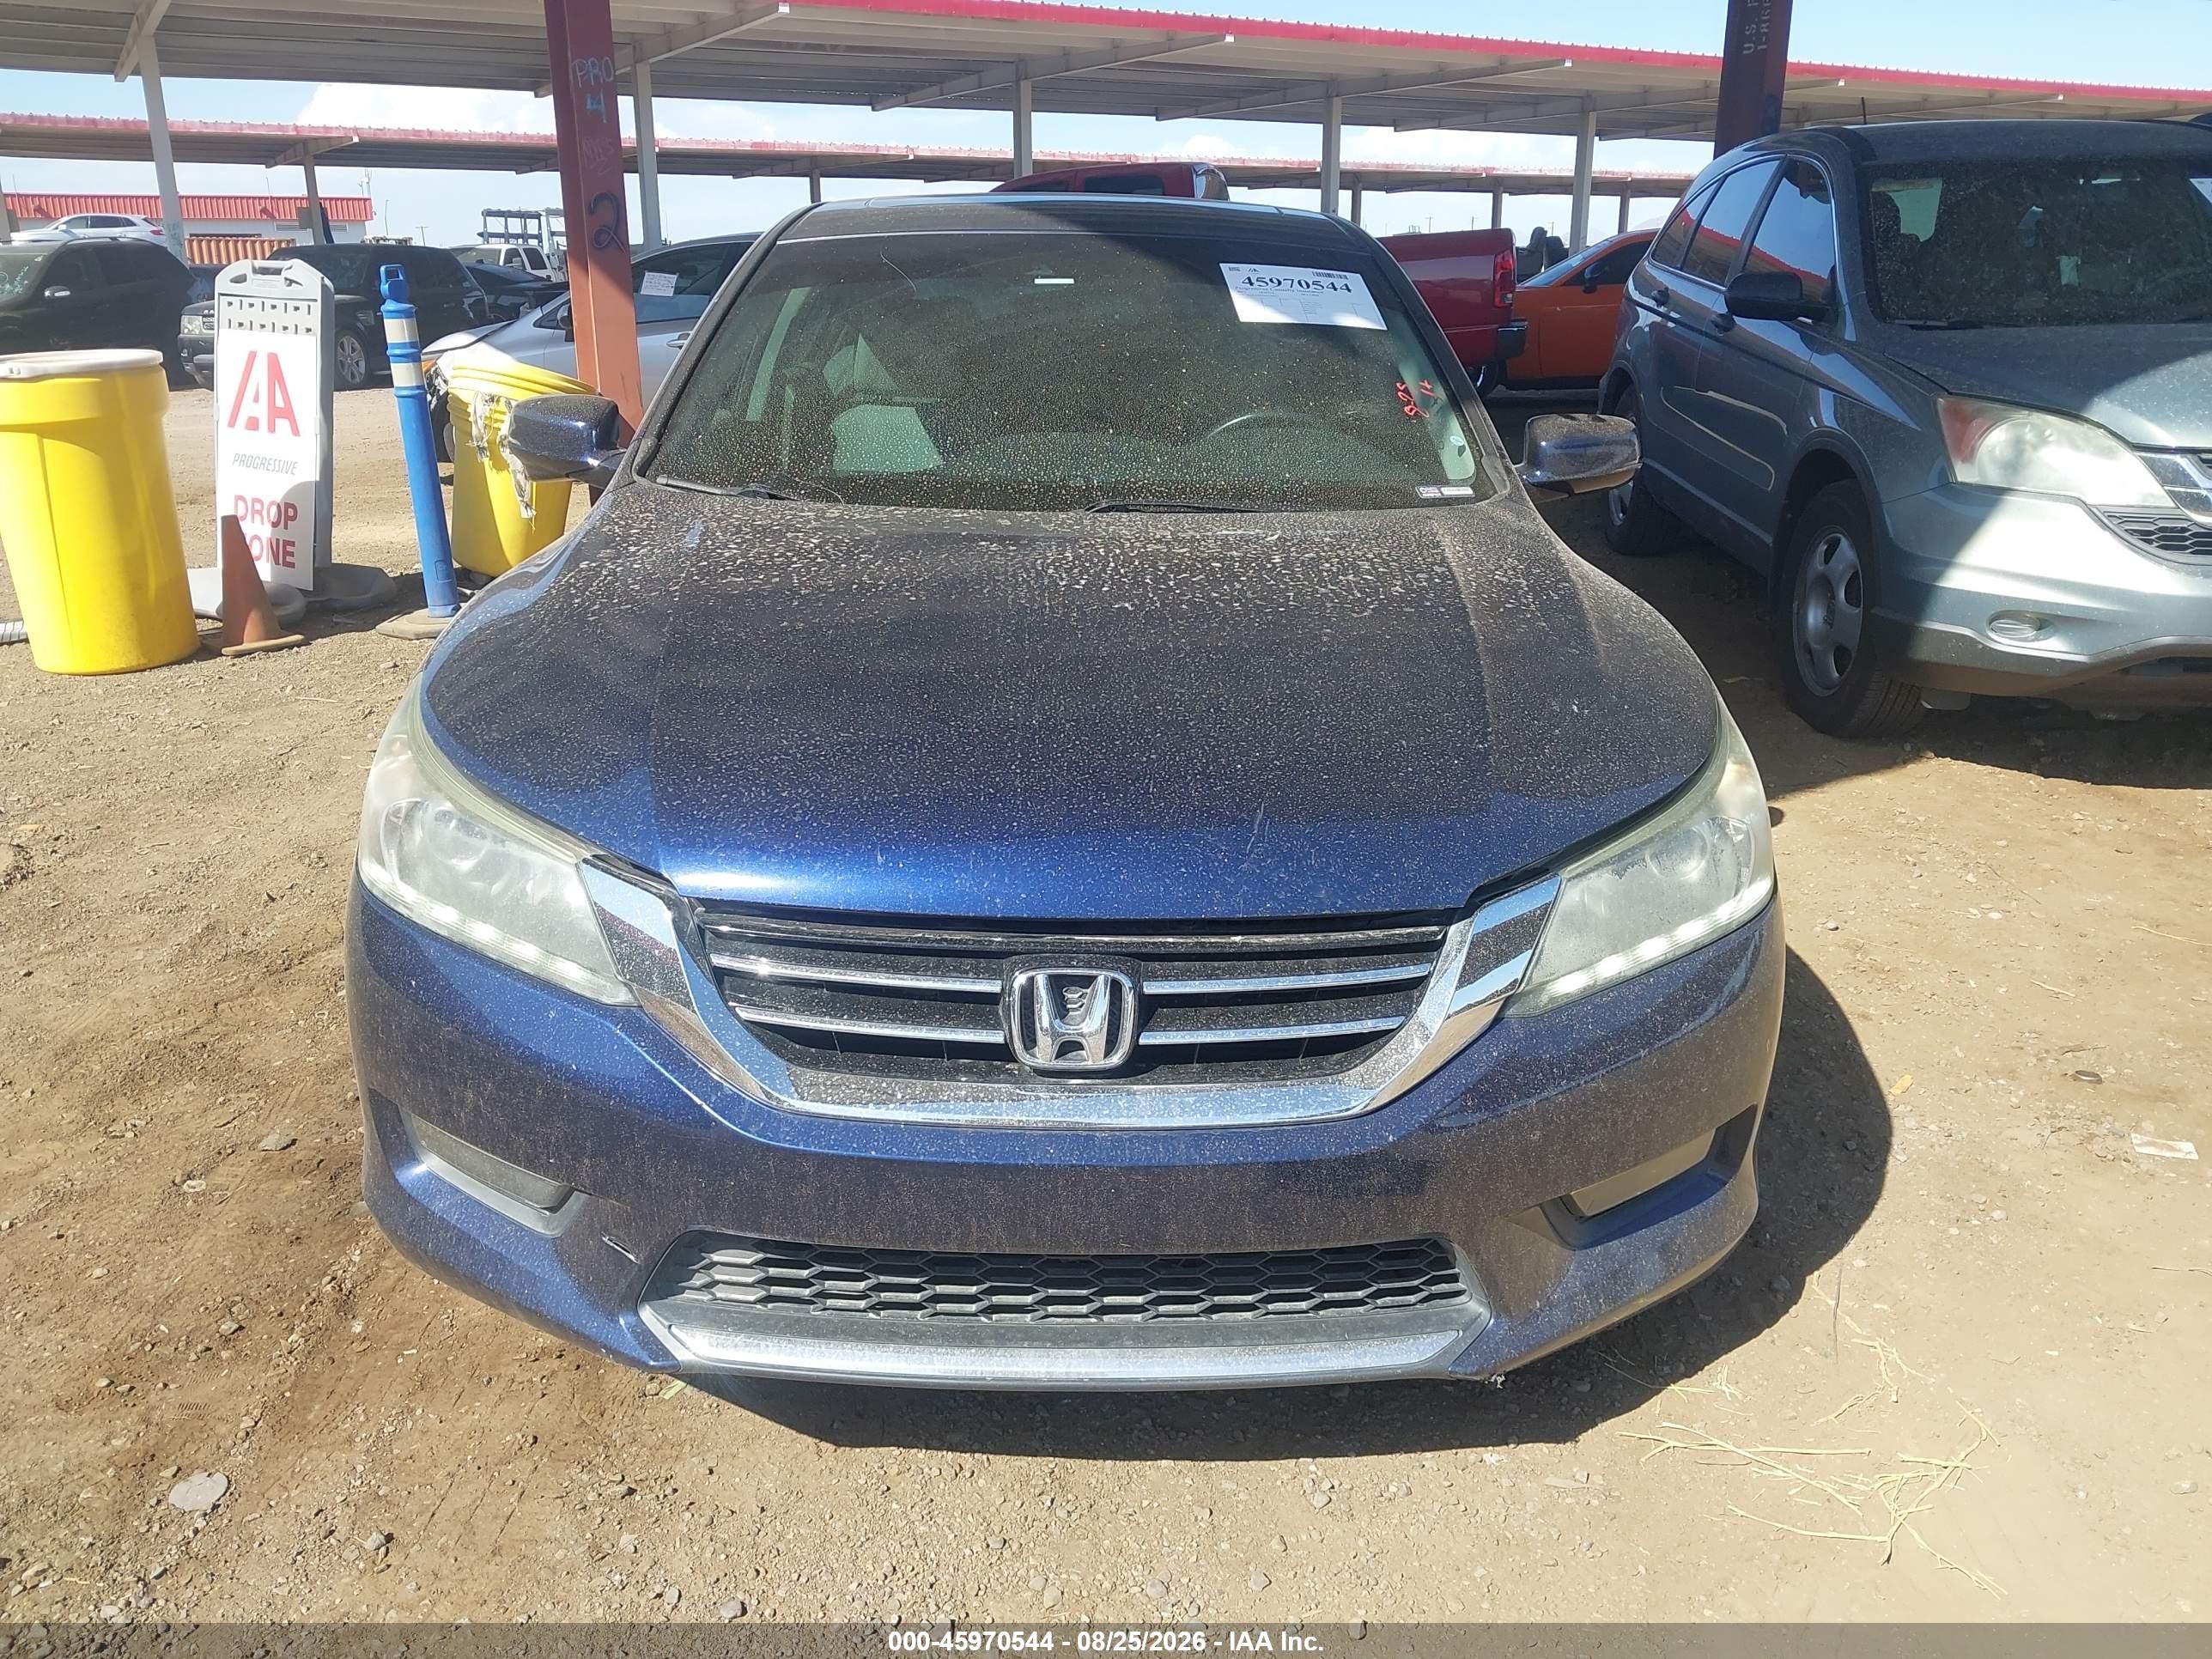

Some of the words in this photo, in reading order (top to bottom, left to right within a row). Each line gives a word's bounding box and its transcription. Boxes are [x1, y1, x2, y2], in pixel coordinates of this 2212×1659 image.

[572, 57, 614, 88] PRO
[587, 191, 626, 253] 2
[1242, 276, 1352, 294] 45970544
[232, 453, 299, 475] PROGRESSIVE
[234, 494, 298, 531] DROP
[249, 534, 296, 568] ONE
